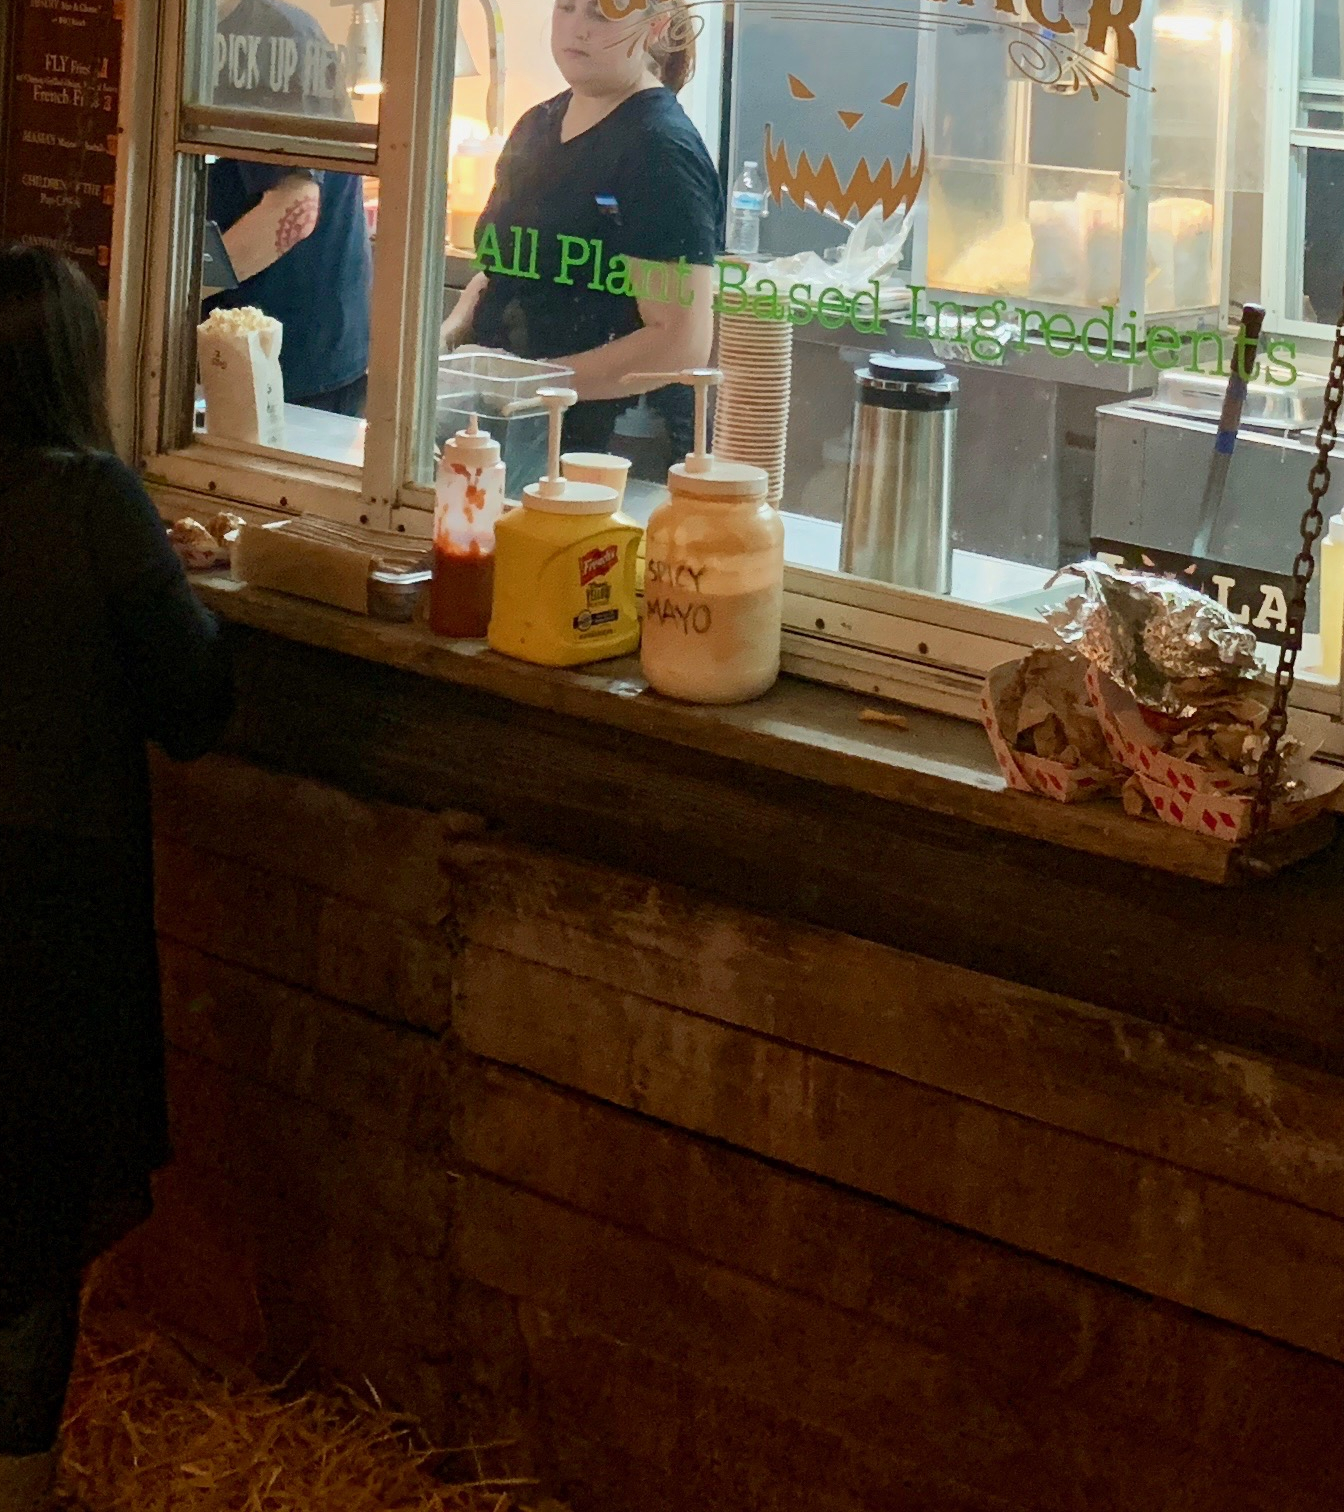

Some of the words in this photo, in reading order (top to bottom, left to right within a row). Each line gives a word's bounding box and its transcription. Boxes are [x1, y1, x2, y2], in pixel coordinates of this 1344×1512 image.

[45, 54, 69, 72] FLY
[212, 32, 262, 89] PICK
[269, 36, 298, 93] UP
[471, 223, 541, 279] All
[554, 232, 695, 308] Plant
[713, 259, 887, 336] Based
[905, 284, 1297, 387] Ingredients
[648, 558, 707, 593] SPICY
[647, 598, 712, 636] MAYO
